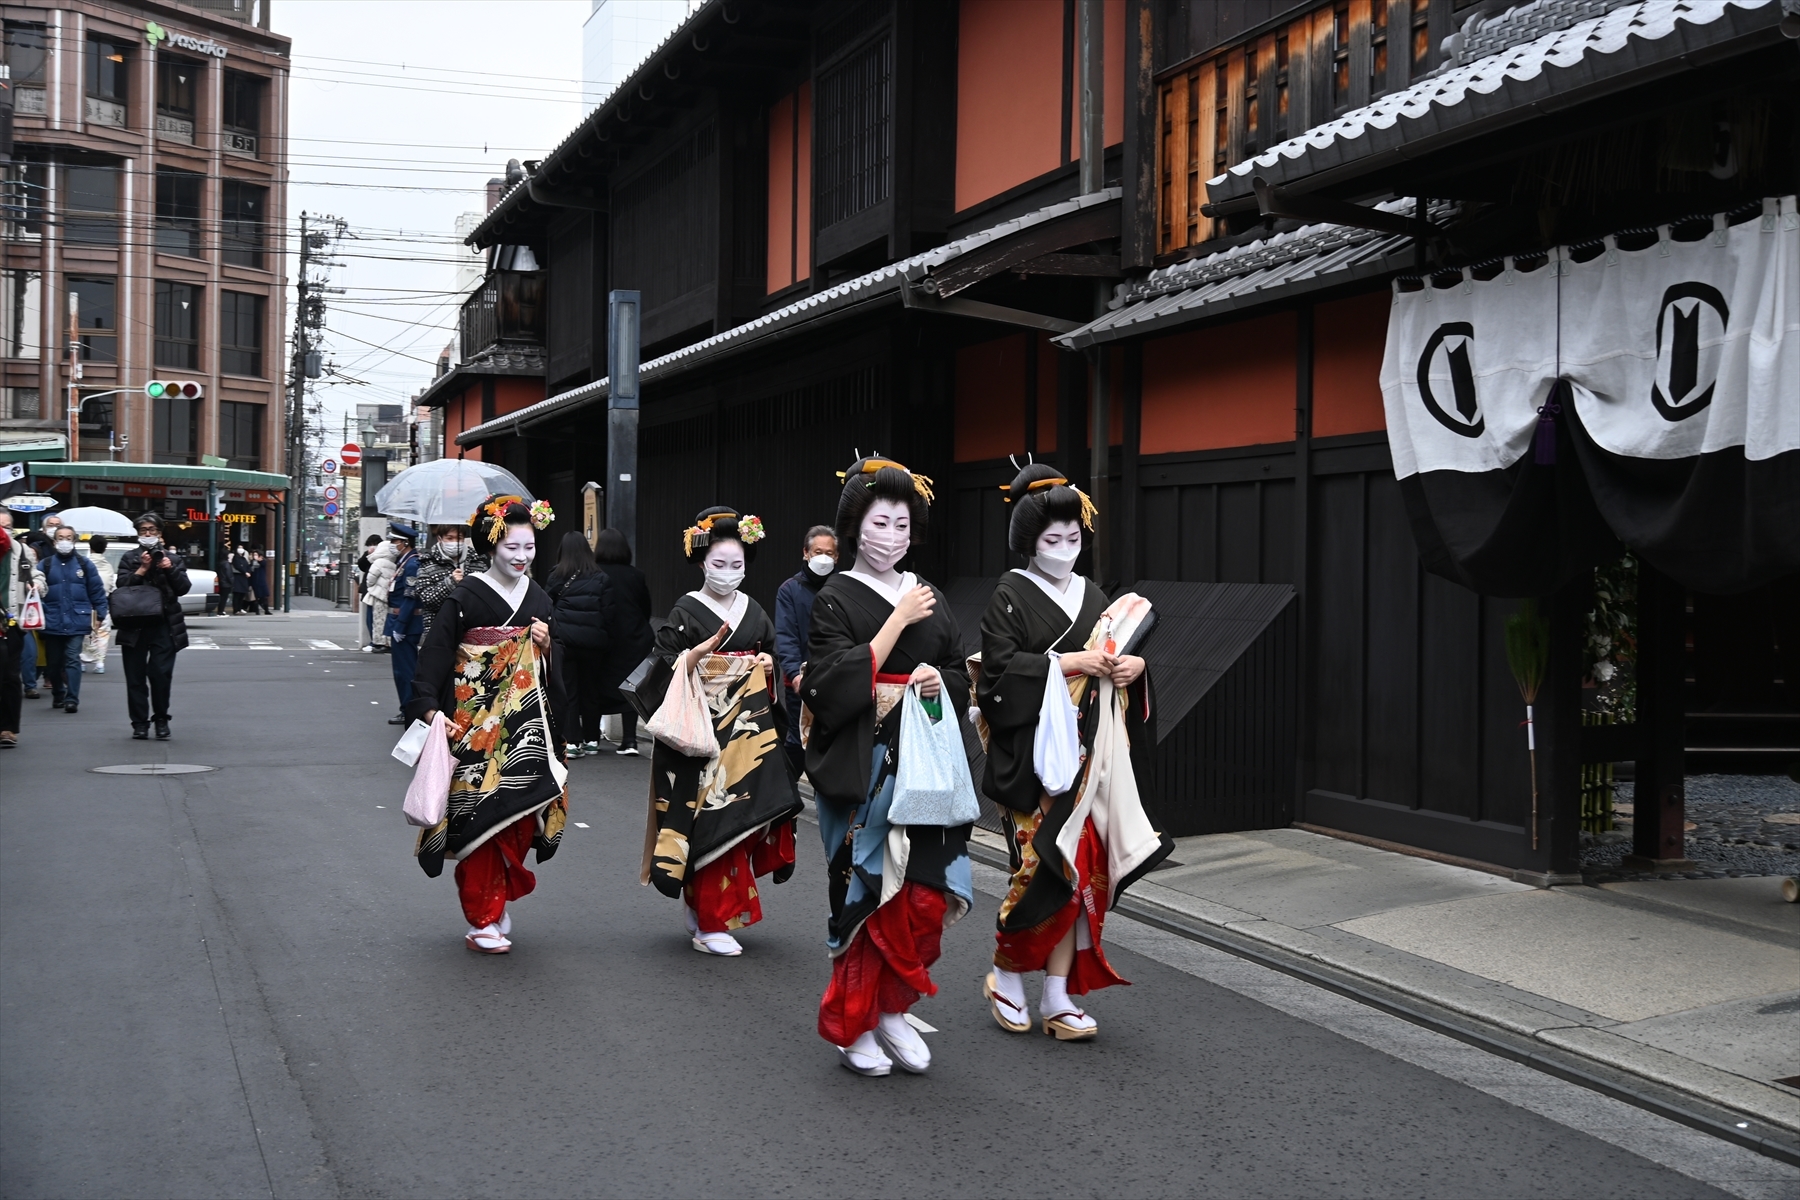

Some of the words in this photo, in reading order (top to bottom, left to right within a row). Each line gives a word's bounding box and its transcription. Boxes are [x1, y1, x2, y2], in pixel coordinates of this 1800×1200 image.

[167, 31, 228, 58] yasaka
[235, 137, 250, 149] 5F
[222, 513, 257, 524] COFFEE
